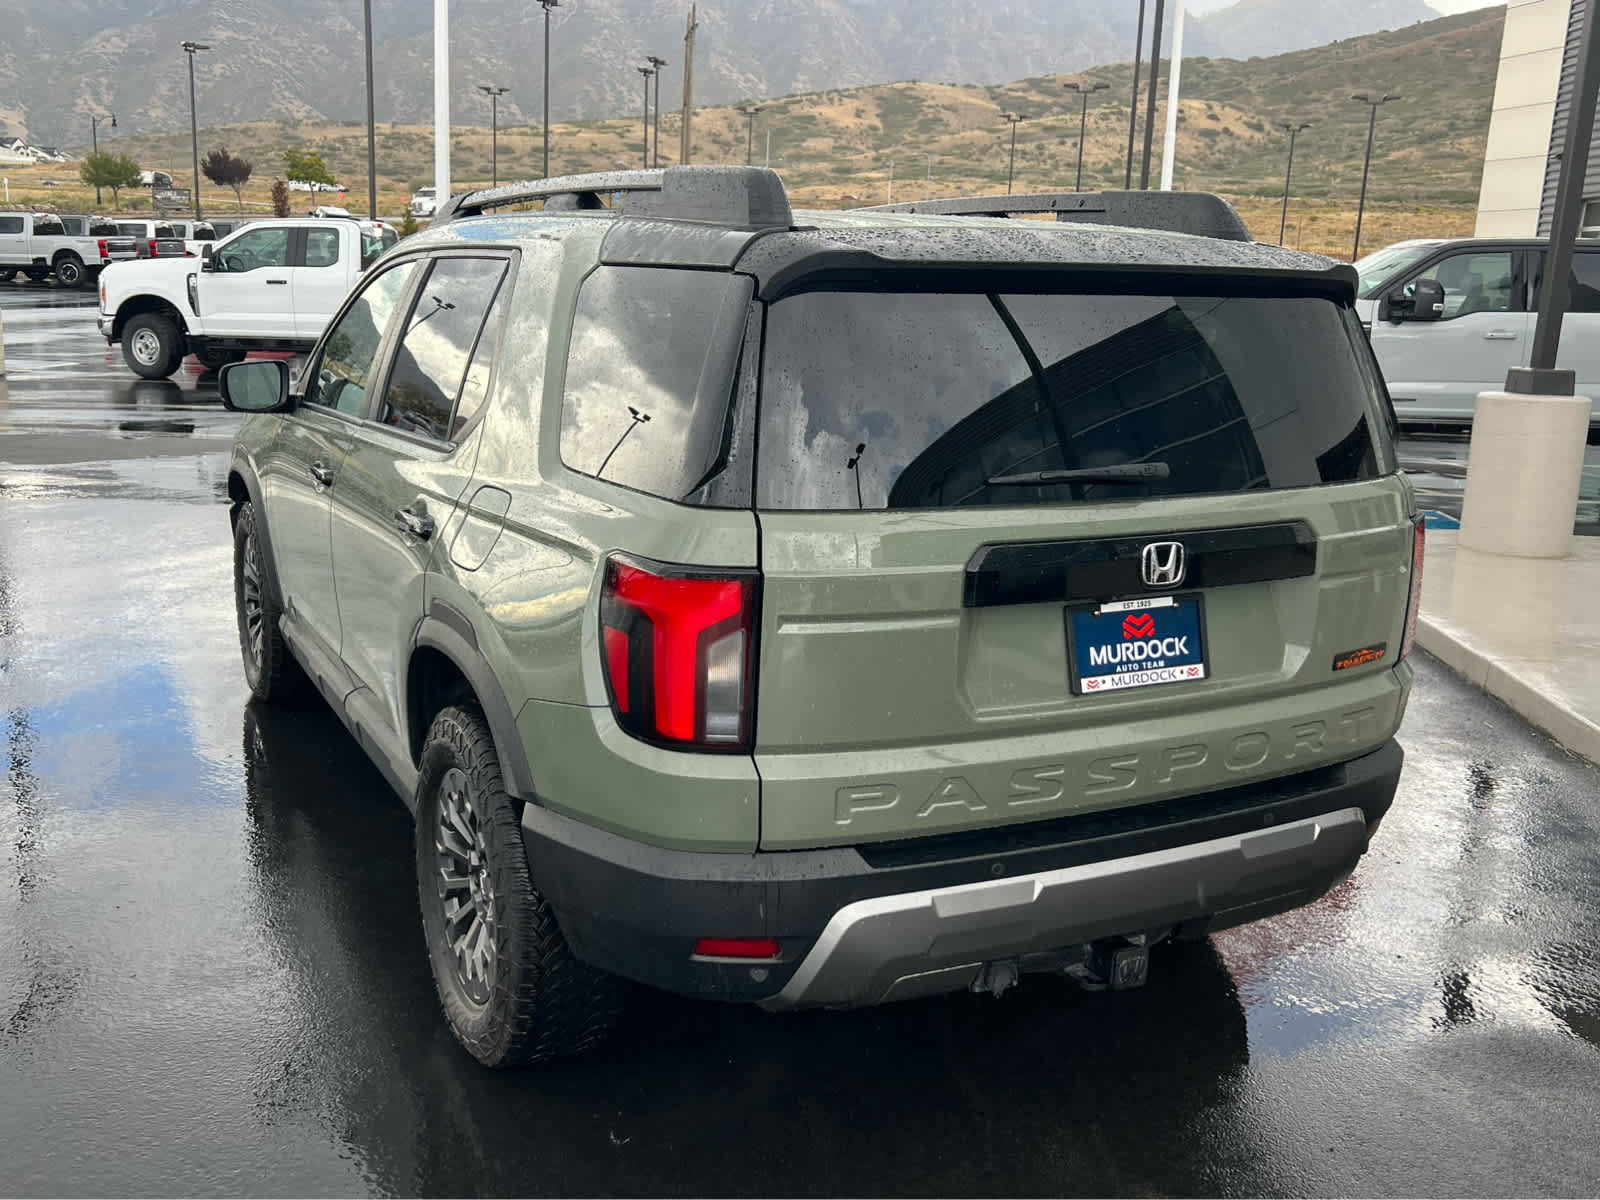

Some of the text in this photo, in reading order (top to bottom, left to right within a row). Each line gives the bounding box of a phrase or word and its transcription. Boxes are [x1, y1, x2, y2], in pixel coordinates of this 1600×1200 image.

[1089, 635, 1189, 667] MURDOCK
[1111, 669, 1178, 687] MURDOCK
[1116, 660, 1165, 673] AUTO TEAM
[833, 706, 1375, 825] PASSPORT
